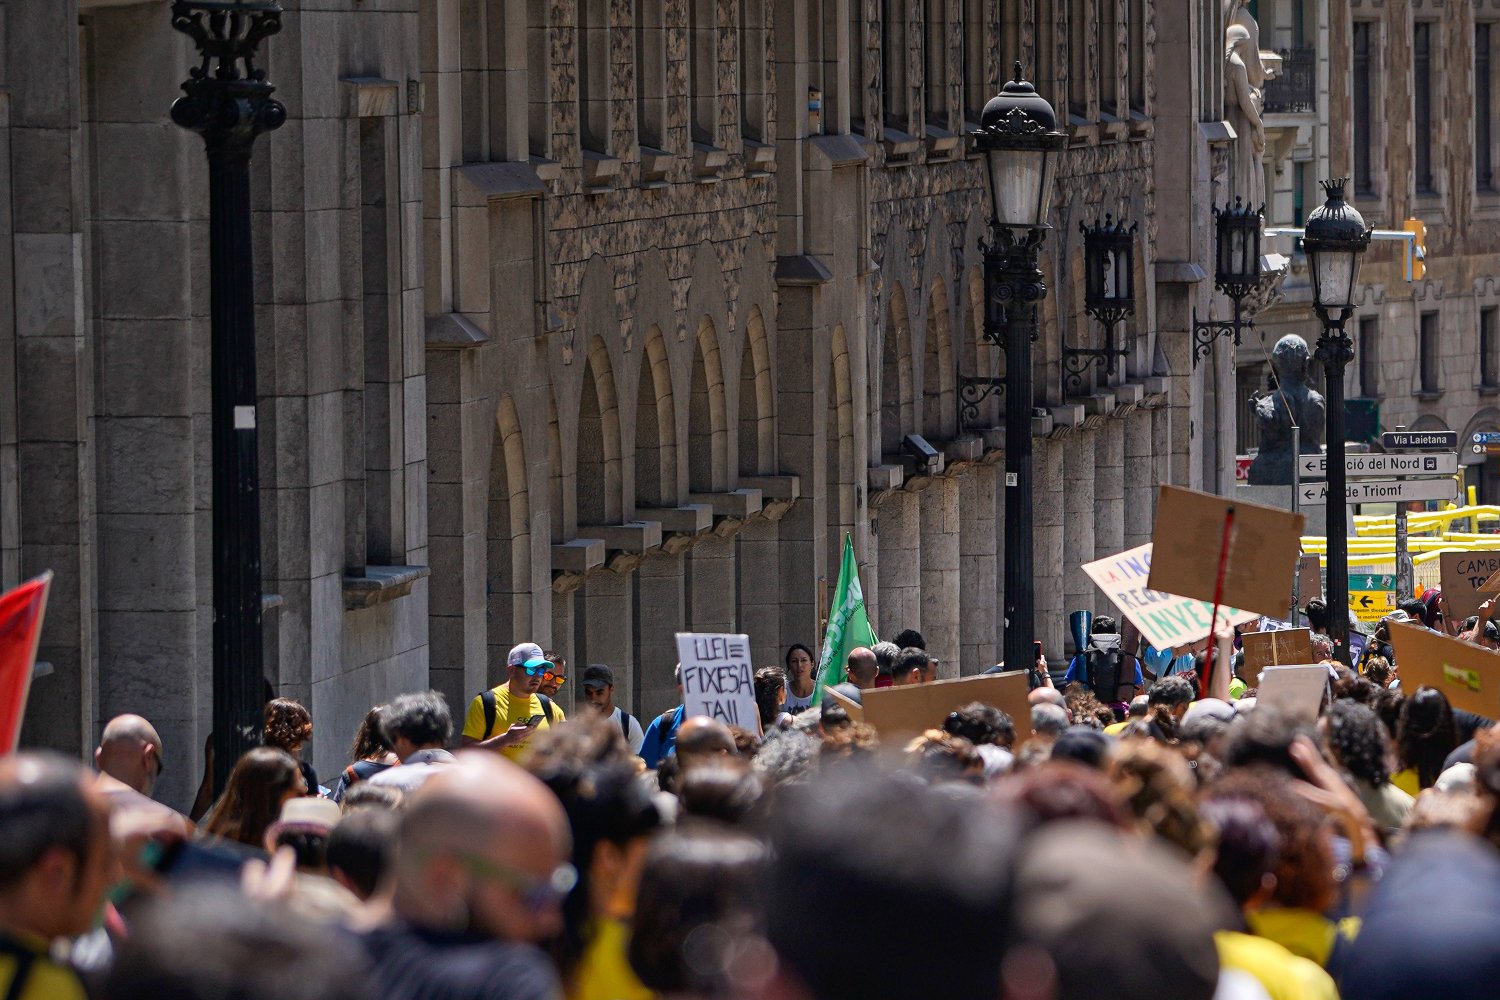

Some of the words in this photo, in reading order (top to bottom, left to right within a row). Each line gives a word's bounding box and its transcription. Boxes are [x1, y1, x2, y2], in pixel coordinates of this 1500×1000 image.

[1394, 436, 1407, 445] Via
[1410, 435, 1447, 445] Laietana
[1320, 456, 1364, 470] Eció
[1368, 456, 1386, 470] del
[1390, 457, 1420, 470] Nord
[1363, 484, 1402, 498] Triomf
